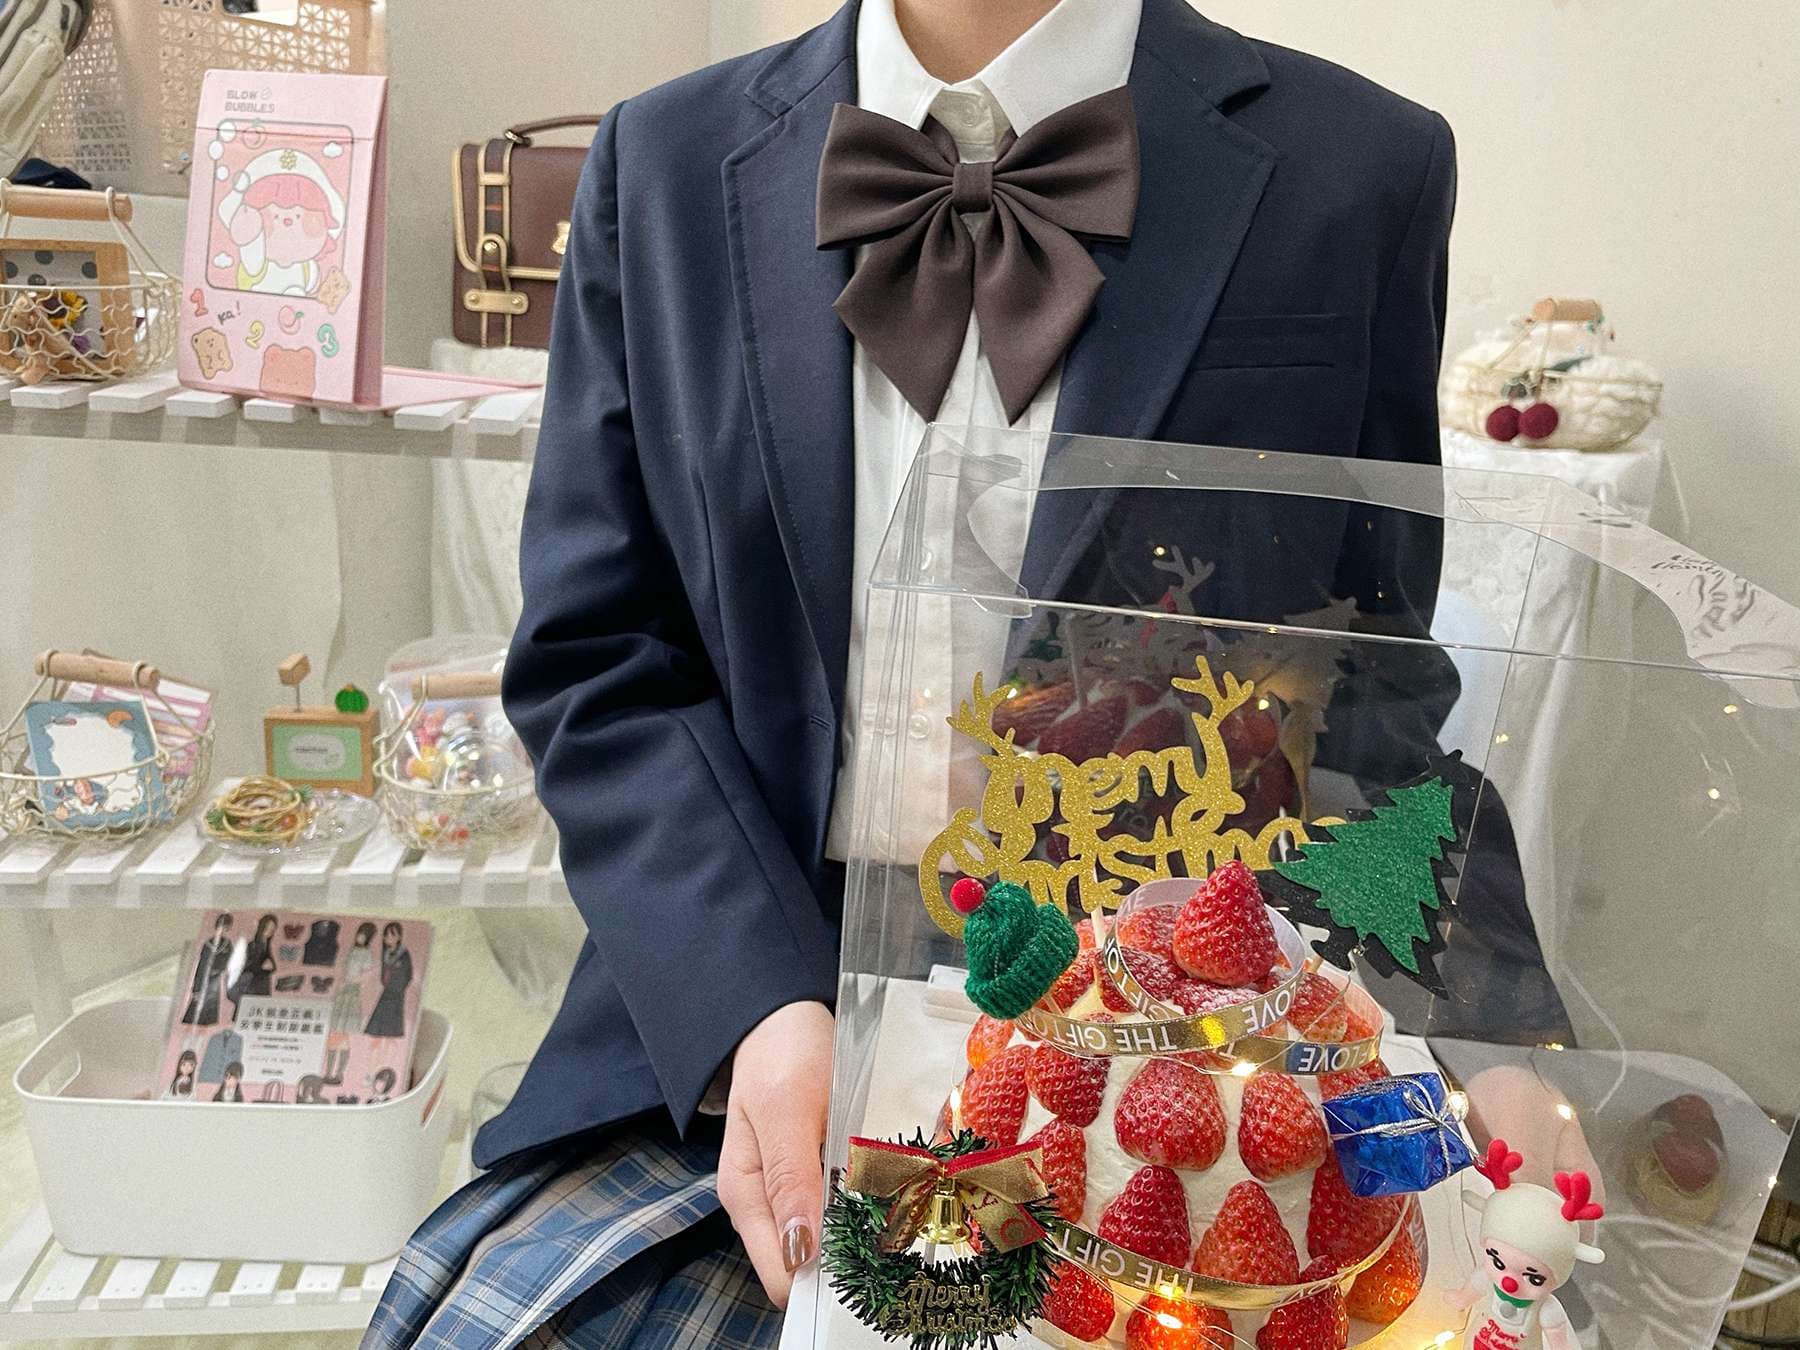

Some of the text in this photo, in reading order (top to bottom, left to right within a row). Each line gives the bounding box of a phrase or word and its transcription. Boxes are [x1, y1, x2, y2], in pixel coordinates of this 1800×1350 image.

[224, 101, 275, 114] BUBBLES
[226, 89, 258, 100] BLOW
[1241, 981, 1297, 1034] LOVE
[1051, 1017, 1108, 1050] GIFT
[1113, 1025, 1177, 1052] THE
[1298, 1045, 1361, 1071] LOVE
[1056, 1226, 1127, 1279] GIFT
[1133, 1260, 1196, 1300] THE
